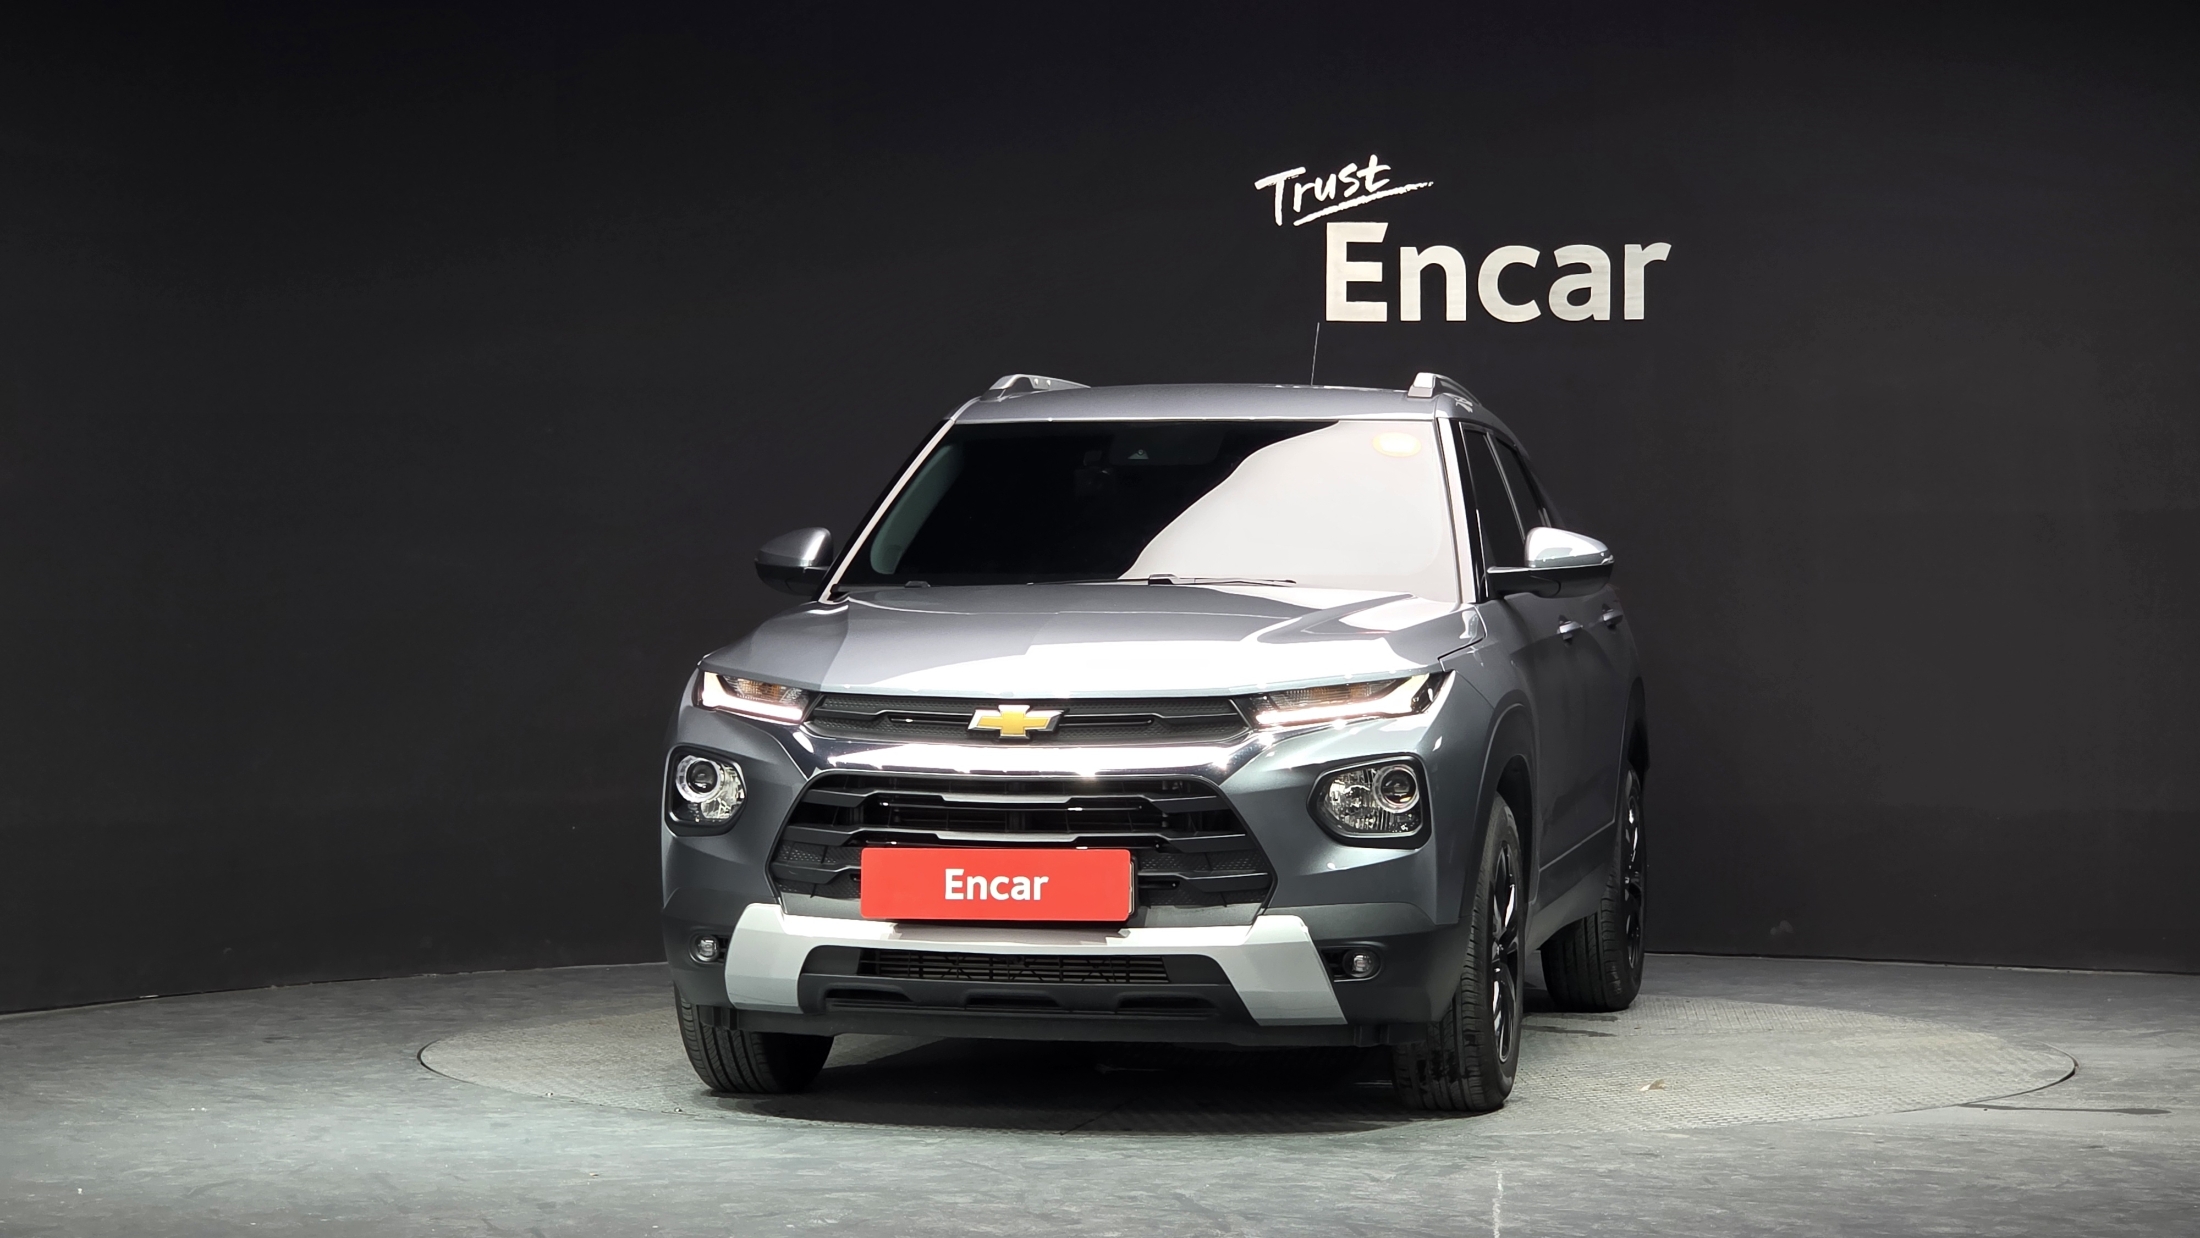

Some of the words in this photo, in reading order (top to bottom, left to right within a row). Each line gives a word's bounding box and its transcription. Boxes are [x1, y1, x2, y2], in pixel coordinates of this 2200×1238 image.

[1254, 153, 1392, 227] Trust
[1325, 221, 1672, 323] Encar
[944, 867, 1050, 901] Encar
